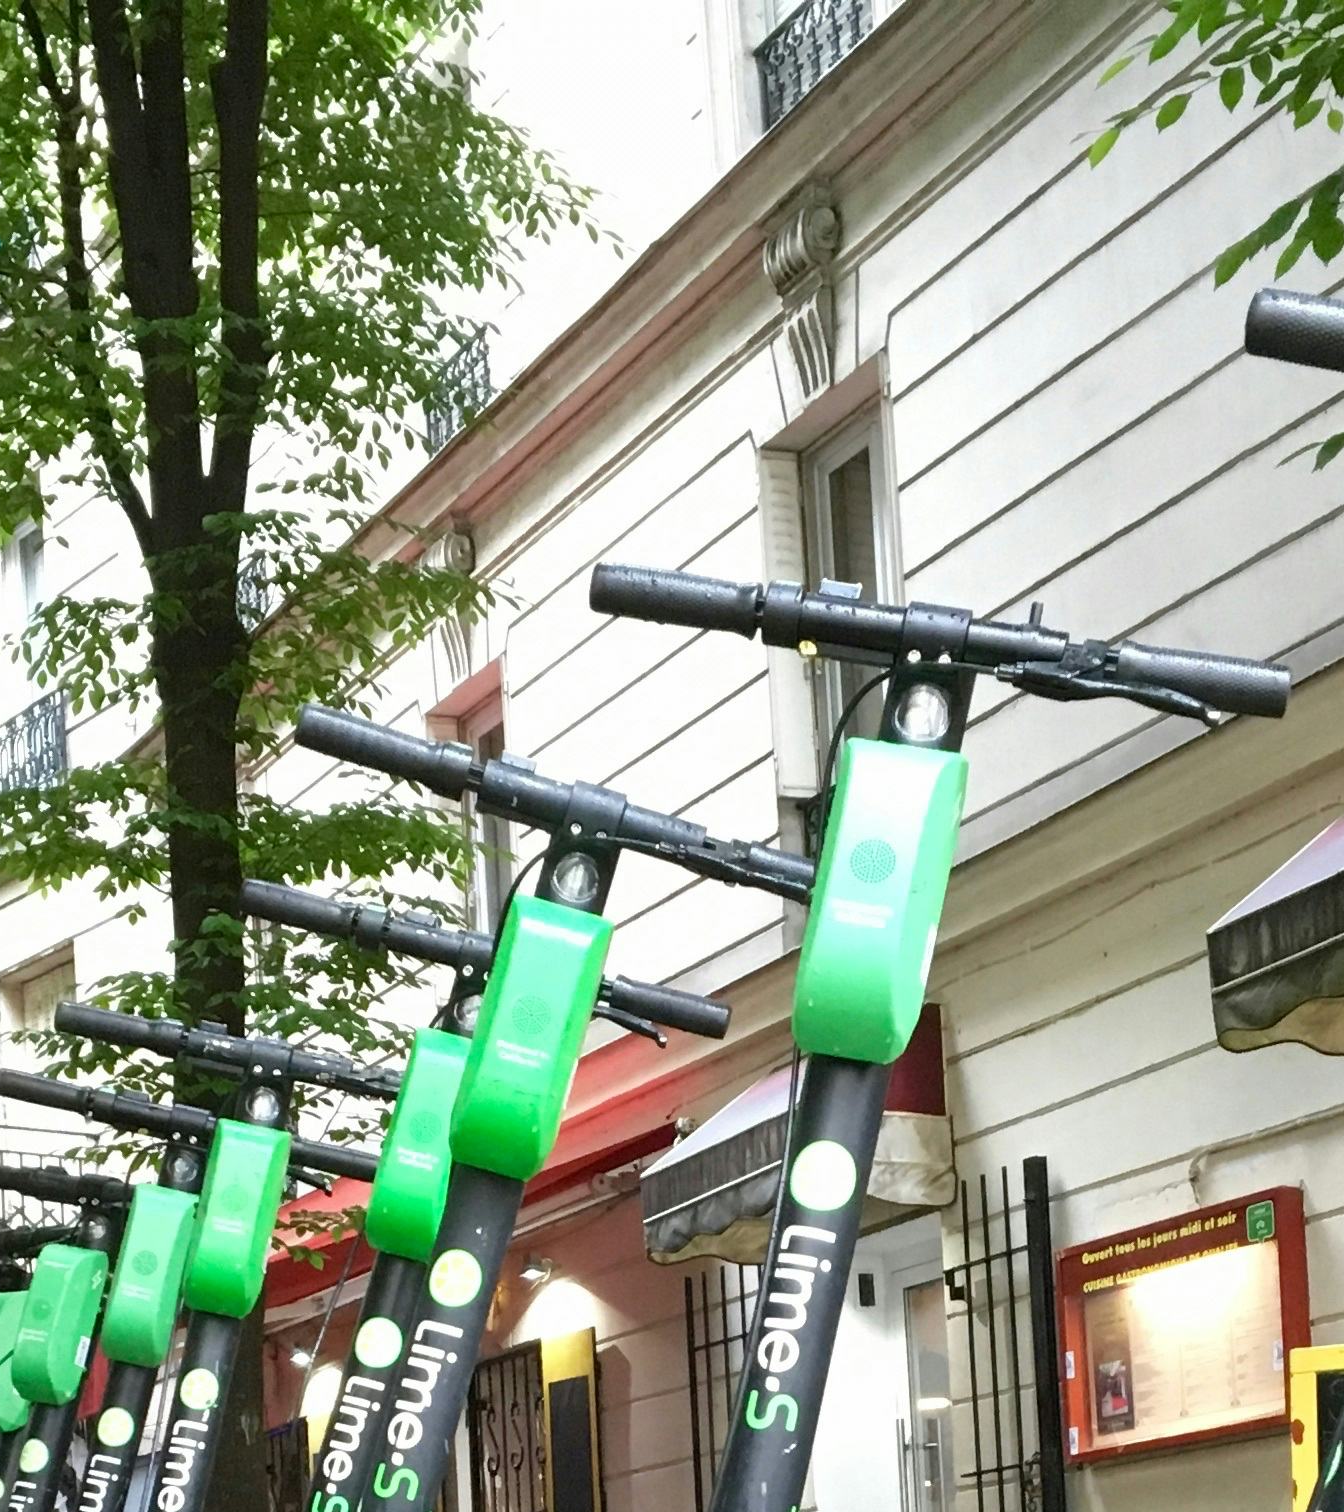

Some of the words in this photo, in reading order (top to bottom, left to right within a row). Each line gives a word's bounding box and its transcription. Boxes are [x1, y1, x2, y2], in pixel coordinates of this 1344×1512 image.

[1082, 1248, 1113, 1265] Ouvert
[1115, 1242, 1135, 1256] tous
[1137, 1236, 1151, 1249] les
[1153, 1229, 1177, 1248] jours
[1179, 1220, 1202, 1237] midi
[1205, 1219, 1215, 1231] et
[1217, 1211, 1237, 1228] soir
[1083, 1275, 1114, 1294] CUISINE
